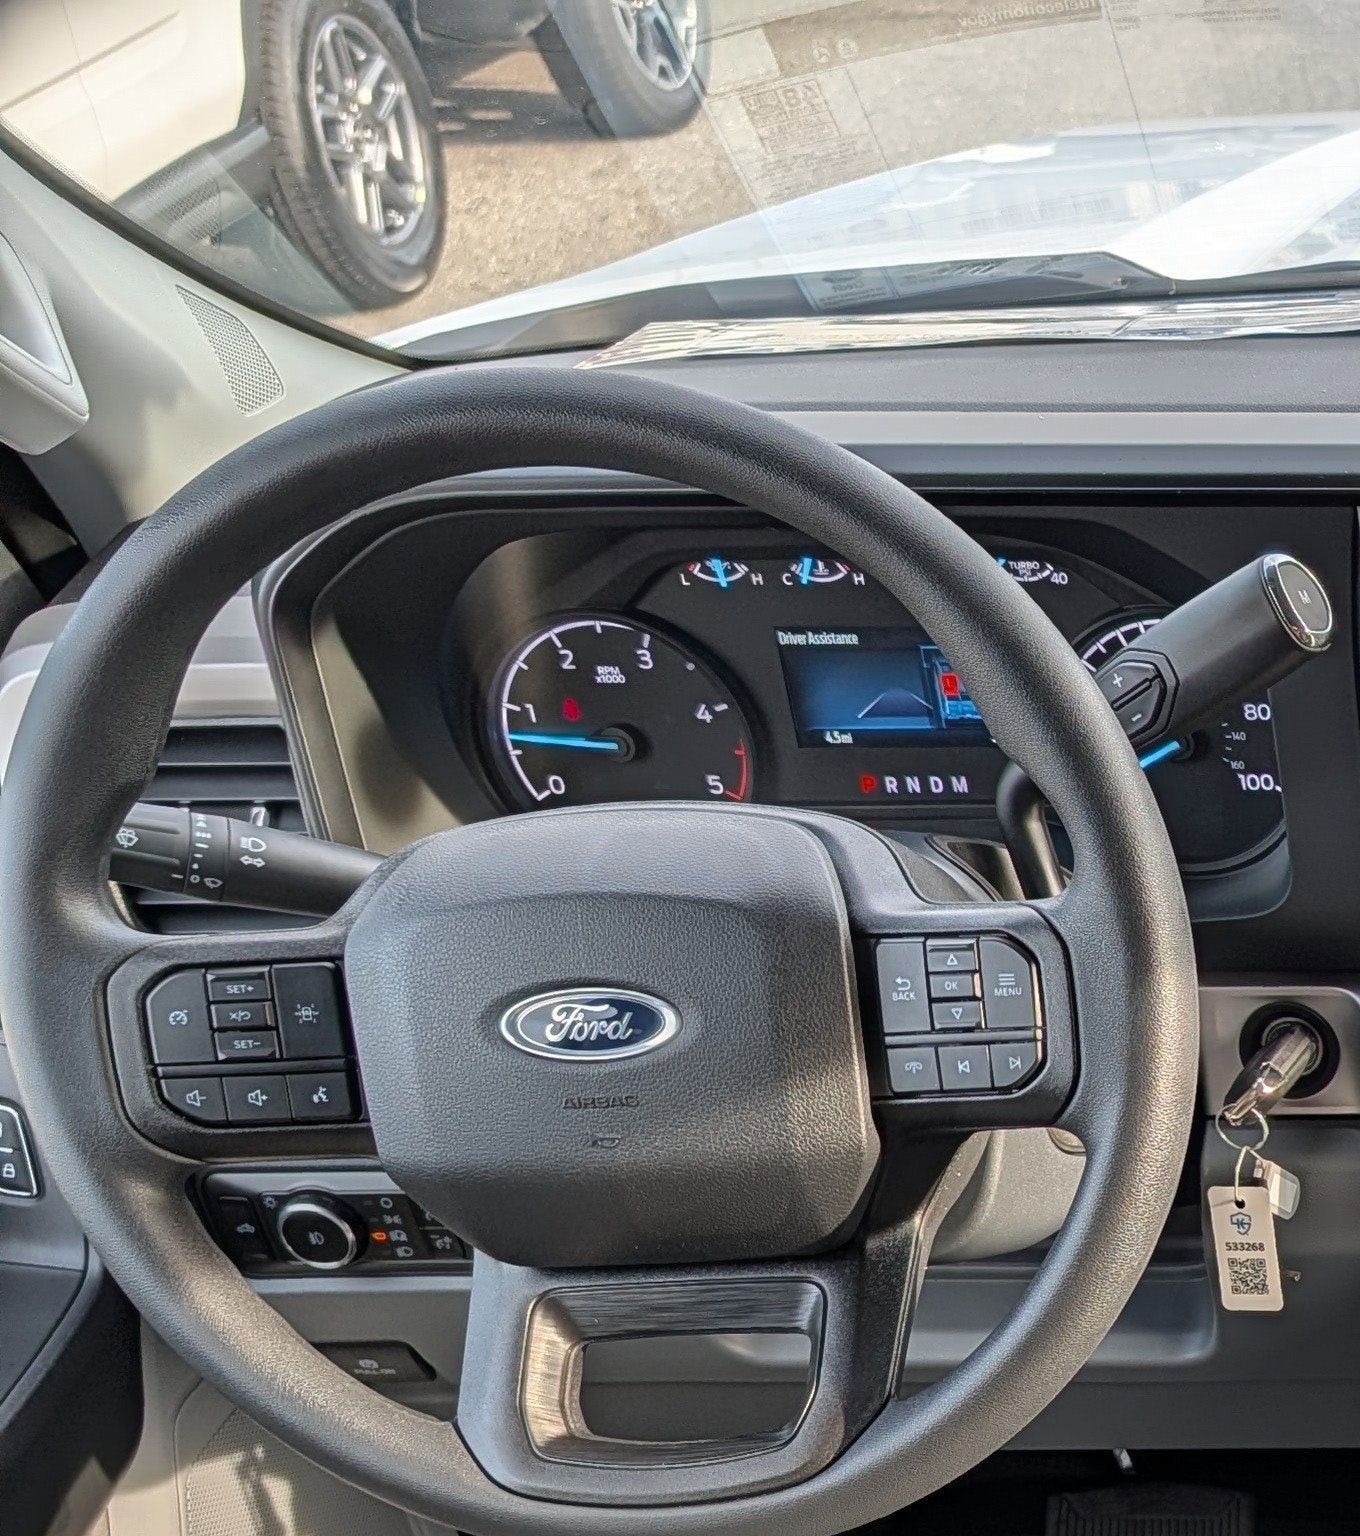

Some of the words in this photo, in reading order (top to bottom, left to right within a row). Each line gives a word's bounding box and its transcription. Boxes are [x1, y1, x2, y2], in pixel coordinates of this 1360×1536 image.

[1008, 561, 1040, 570] TURBO
[679, 574, 690, 586] L
[751, 573, 763, 585] H
[782, 573, 793, 586] C
[854, 572, 865, 586] H
[1050, 571, 1068, 585] 40
[777, 631, 807, 645] Driver
[808, 632, 859, 646] Assistance
[559, 649, 576, 669] 2
[636, 649, 653, 669] 3
[597, 666, 621, 675] RPM
[524, 704, 537, 723] 1
[695, 704, 713, 723] 4
[1244, 704, 1271, 720] 80
[548, 775, 565, 795] 0
[707, 775, 724, 794] 5
[860, 775, 877, 794] P
[885, 777, 897, 793] R
[906, 777, 921, 793] N
[930, 777, 943, 793] D
[952, 777, 969, 793] M
[1238, 774, 1274, 791] 100
[944, 981, 958, 991] OK
[994, 987, 1022, 997] MENU
[892, 991, 916, 1001] BACK
[545, 1003, 634, 1042] Ford
[1225, 1242, 1265, 1252] 533268
